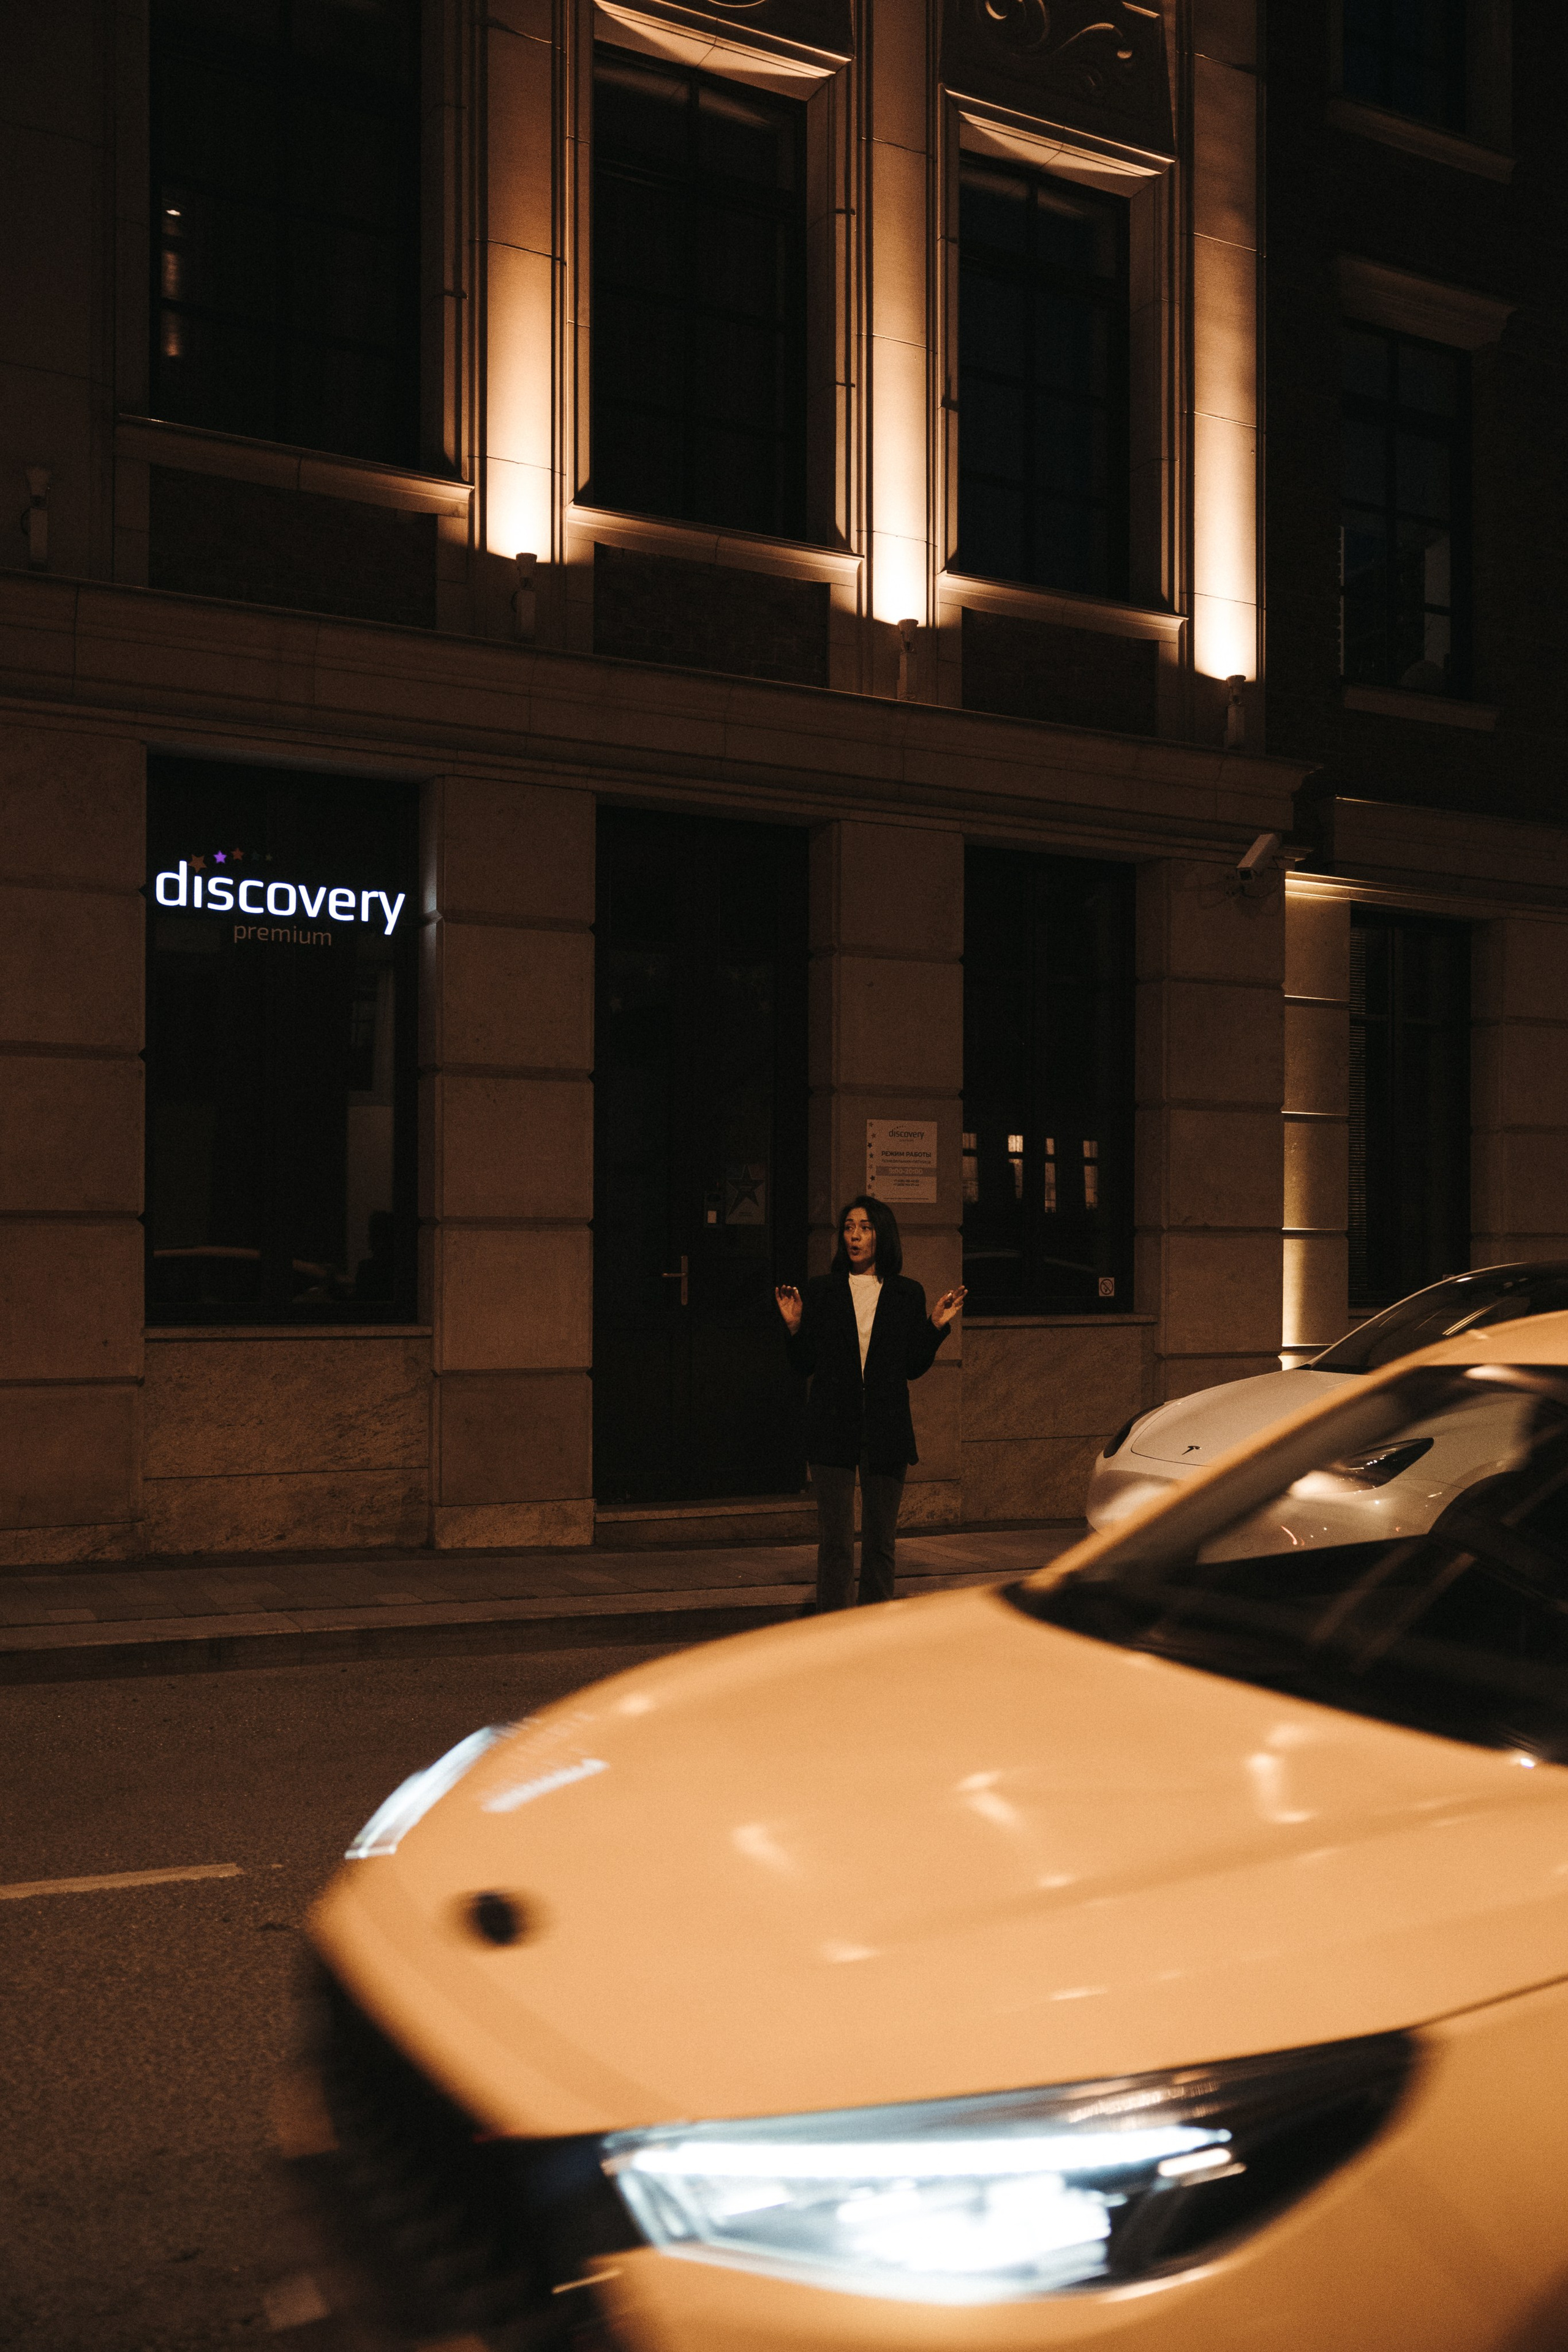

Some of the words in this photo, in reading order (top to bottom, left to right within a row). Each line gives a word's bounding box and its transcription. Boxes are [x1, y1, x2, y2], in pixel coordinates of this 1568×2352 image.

[156, 860, 405, 935] discovery
[233, 925, 331, 946] premium
[888, 1129, 924, 1139] discovery
